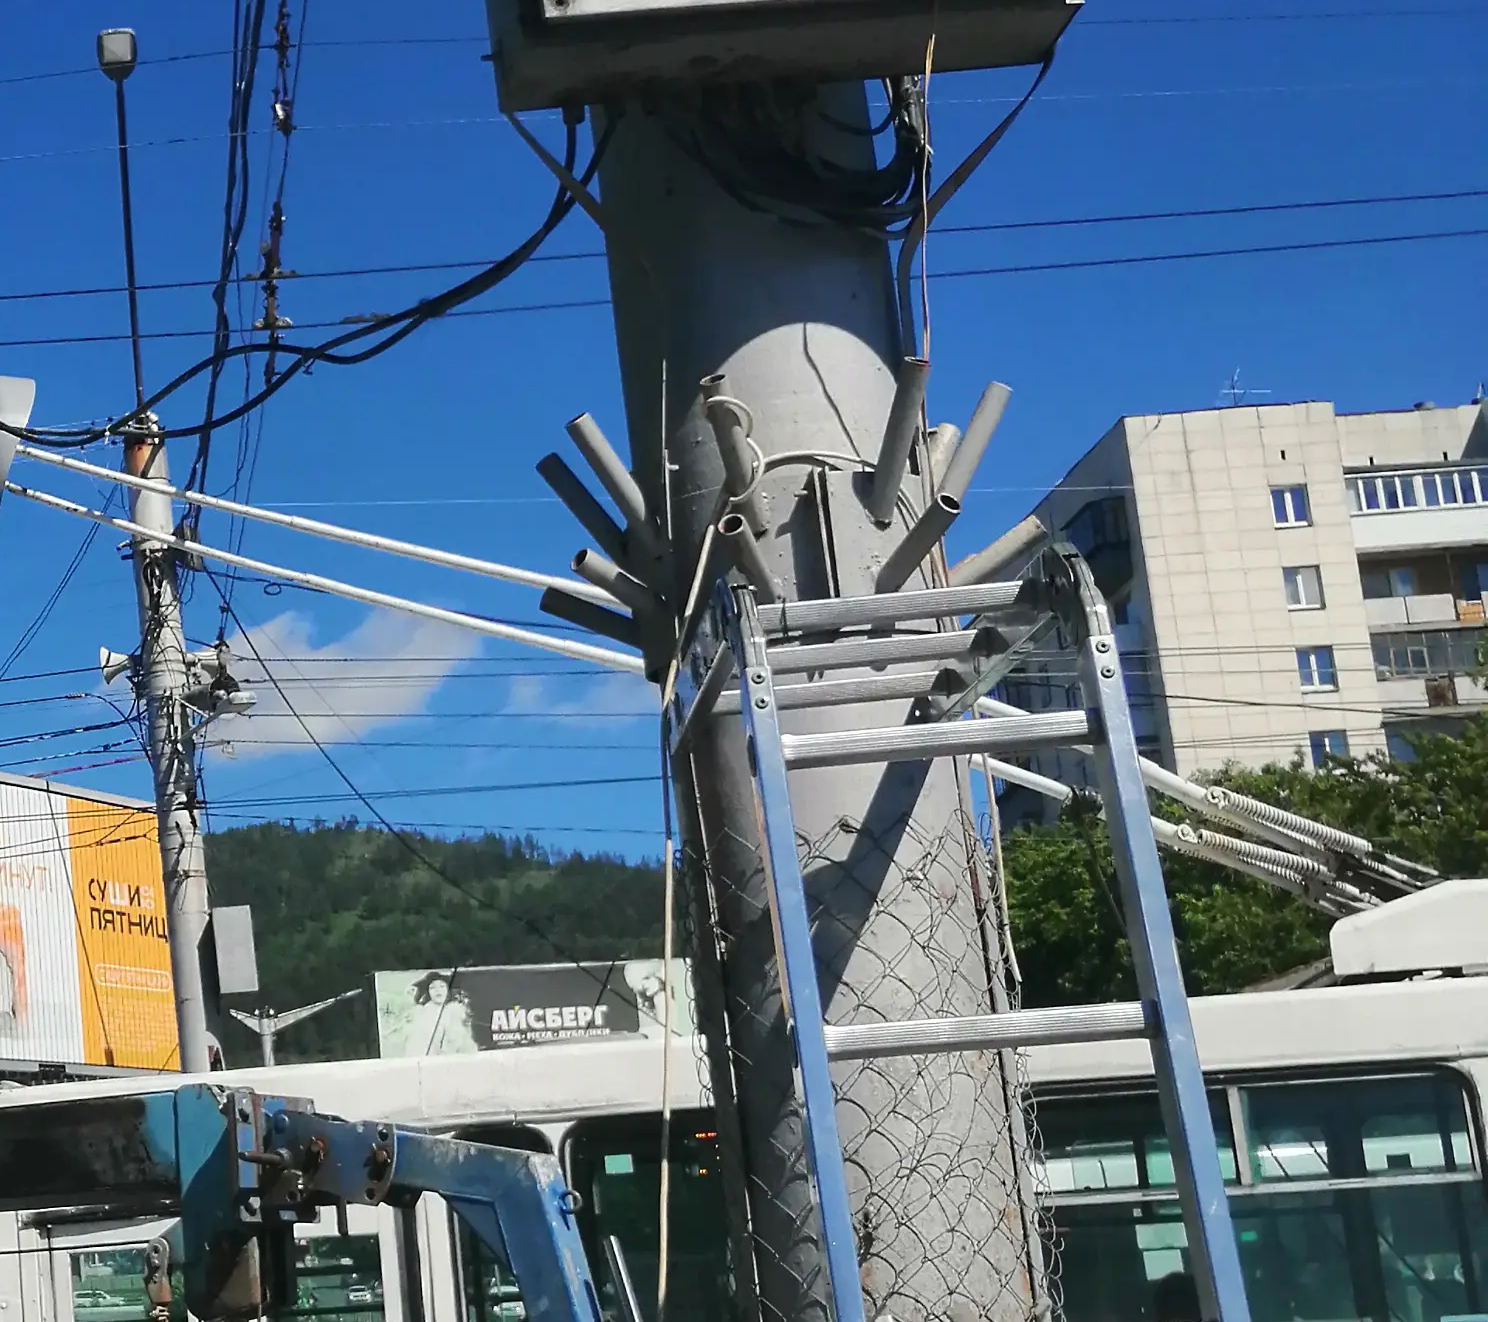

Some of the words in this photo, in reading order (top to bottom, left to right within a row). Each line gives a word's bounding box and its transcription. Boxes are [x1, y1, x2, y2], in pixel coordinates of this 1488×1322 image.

[88, 878, 141, 907] СУШИ
[90, 906, 169, 943] ПЯТНИЦ
[491, 1005, 608, 1031] АЙСБЕРГ
